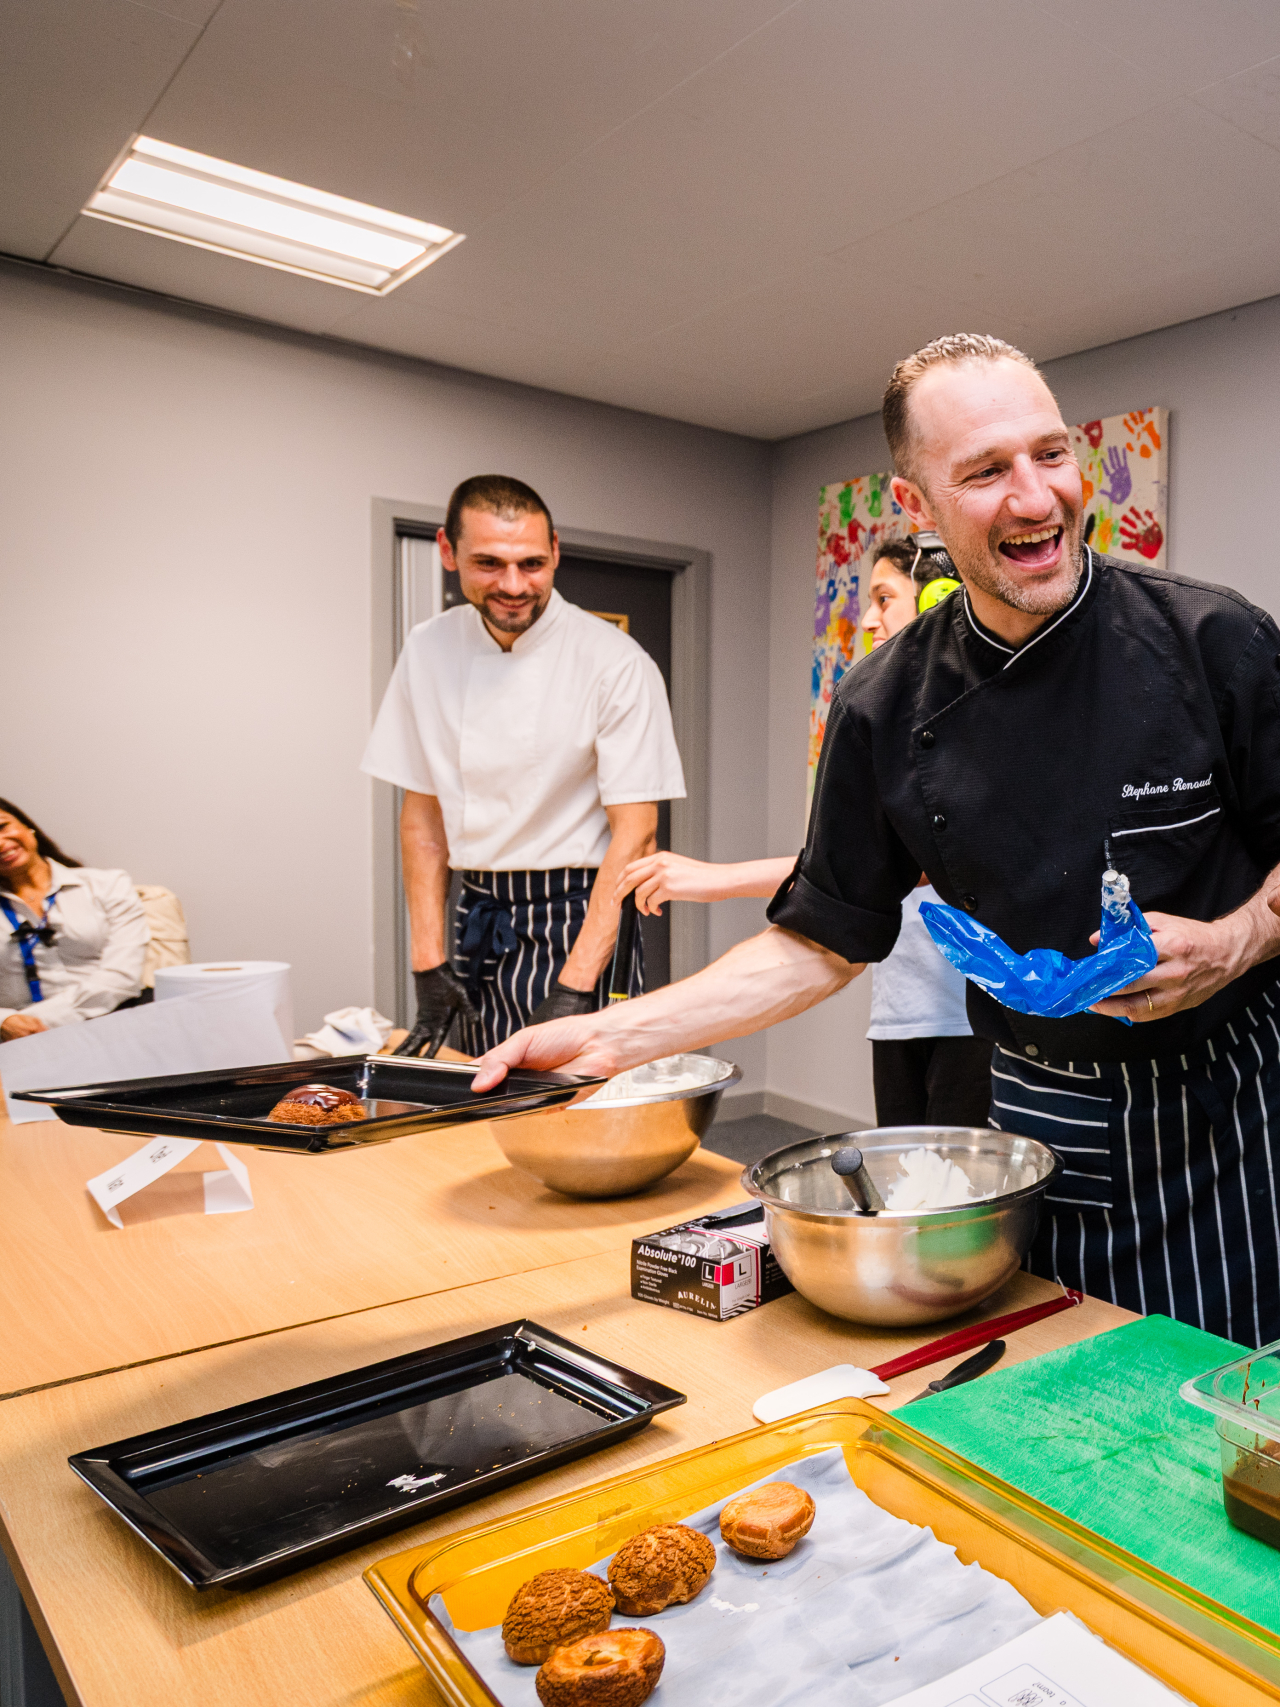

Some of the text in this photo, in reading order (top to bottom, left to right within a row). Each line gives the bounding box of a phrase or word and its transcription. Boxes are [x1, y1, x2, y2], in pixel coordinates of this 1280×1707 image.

[1121, 772, 1213, 801] Stephane Renaud
[705, 1266, 712, 1279] L
[739, 1263, 746, 1276] L
